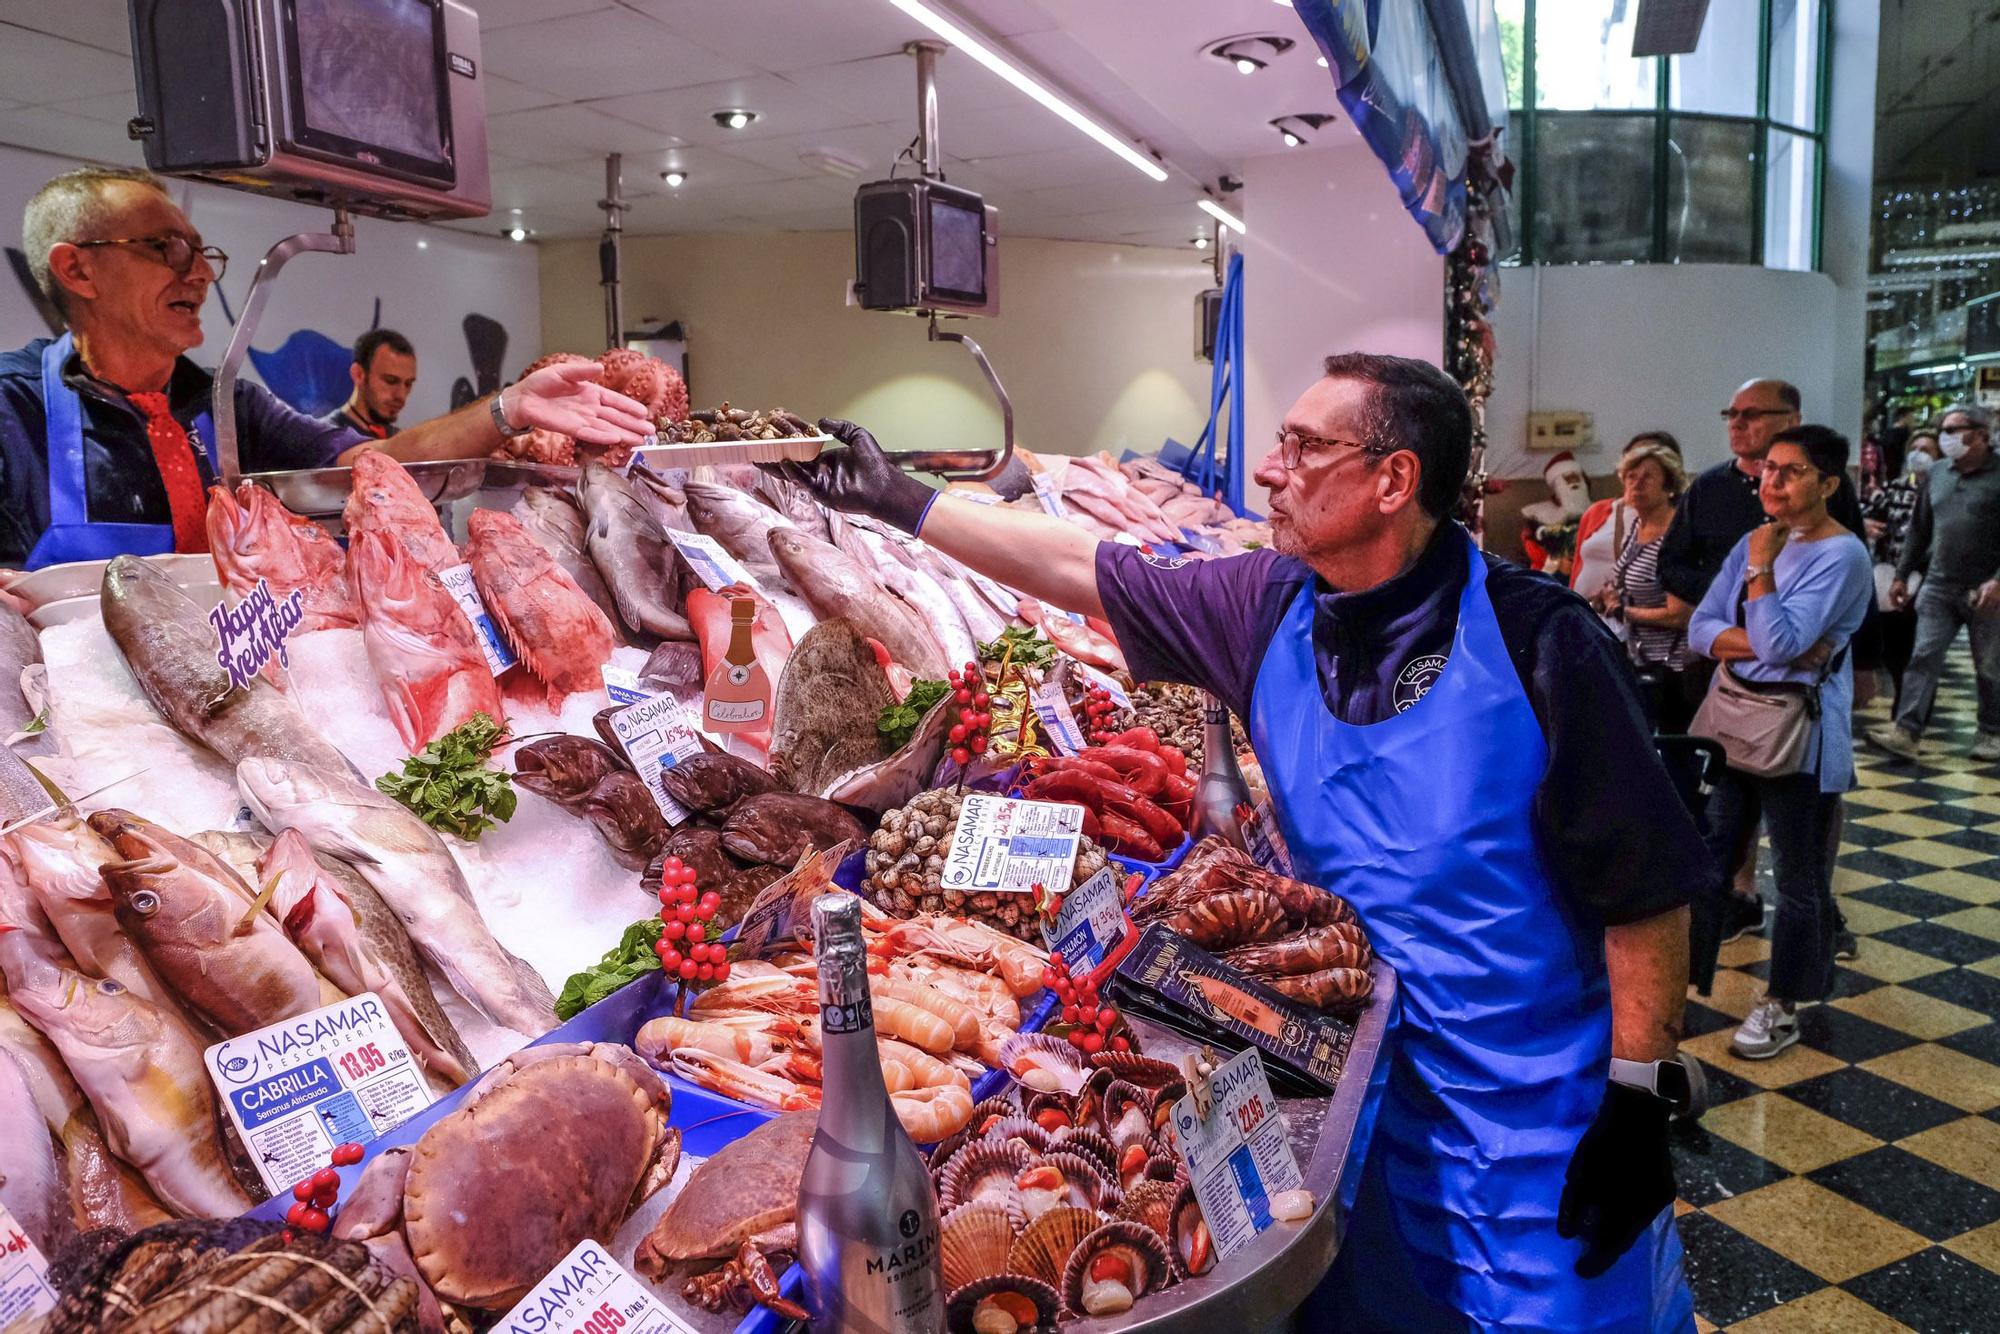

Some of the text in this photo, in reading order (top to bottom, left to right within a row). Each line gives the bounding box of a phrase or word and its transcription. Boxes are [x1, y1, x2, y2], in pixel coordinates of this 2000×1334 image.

[209, 579, 277, 668] Happy
[258, 591, 303, 669] Year
[627, 697, 677, 726] NASAMAR
[953, 797, 983, 864] NASAMAR
[1060, 873, 1112, 925] NASAMAR
[1061, 928, 1088, 958] SALMÓN
[257, 1000, 382, 1061] NASAMAR
[267, 1022, 386, 1072] PESCADERÍA
[340, 1042, 386, 1081] 13,95
[241, 1064, 328, 1110] CABRILLA
[256, 1101, 290, 1121] Serranus
[1238, 1094, 1265, 1133] 22,95
